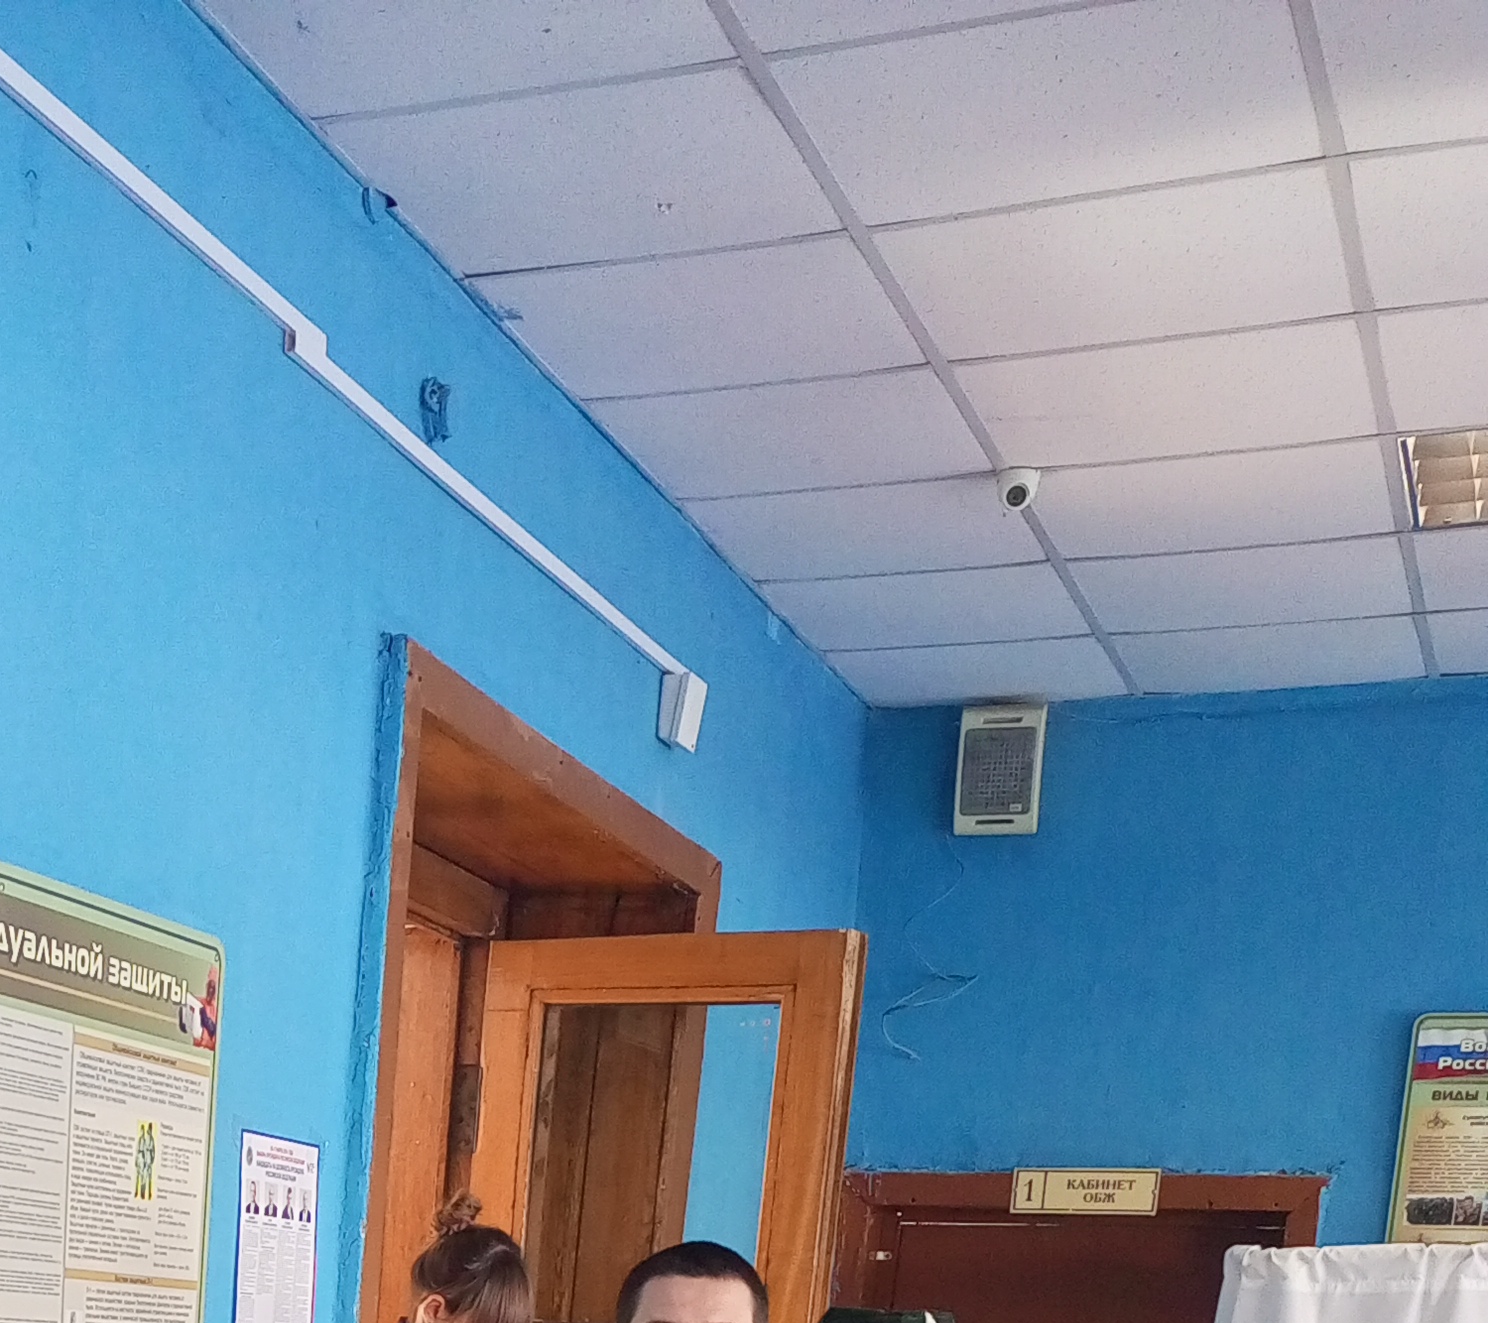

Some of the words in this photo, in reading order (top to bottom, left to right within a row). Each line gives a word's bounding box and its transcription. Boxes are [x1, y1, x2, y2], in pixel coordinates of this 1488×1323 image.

[108, 955, 188, 1006] защиты
[1431, 1090, 1478, 1101] ВИДЫ
[1024, 1179, 1033, 1201] 1
[1067, 1179, 1136, 1190] КАБИНЕТ
[1083, 1193, 1115, 1203] ОБЖ
